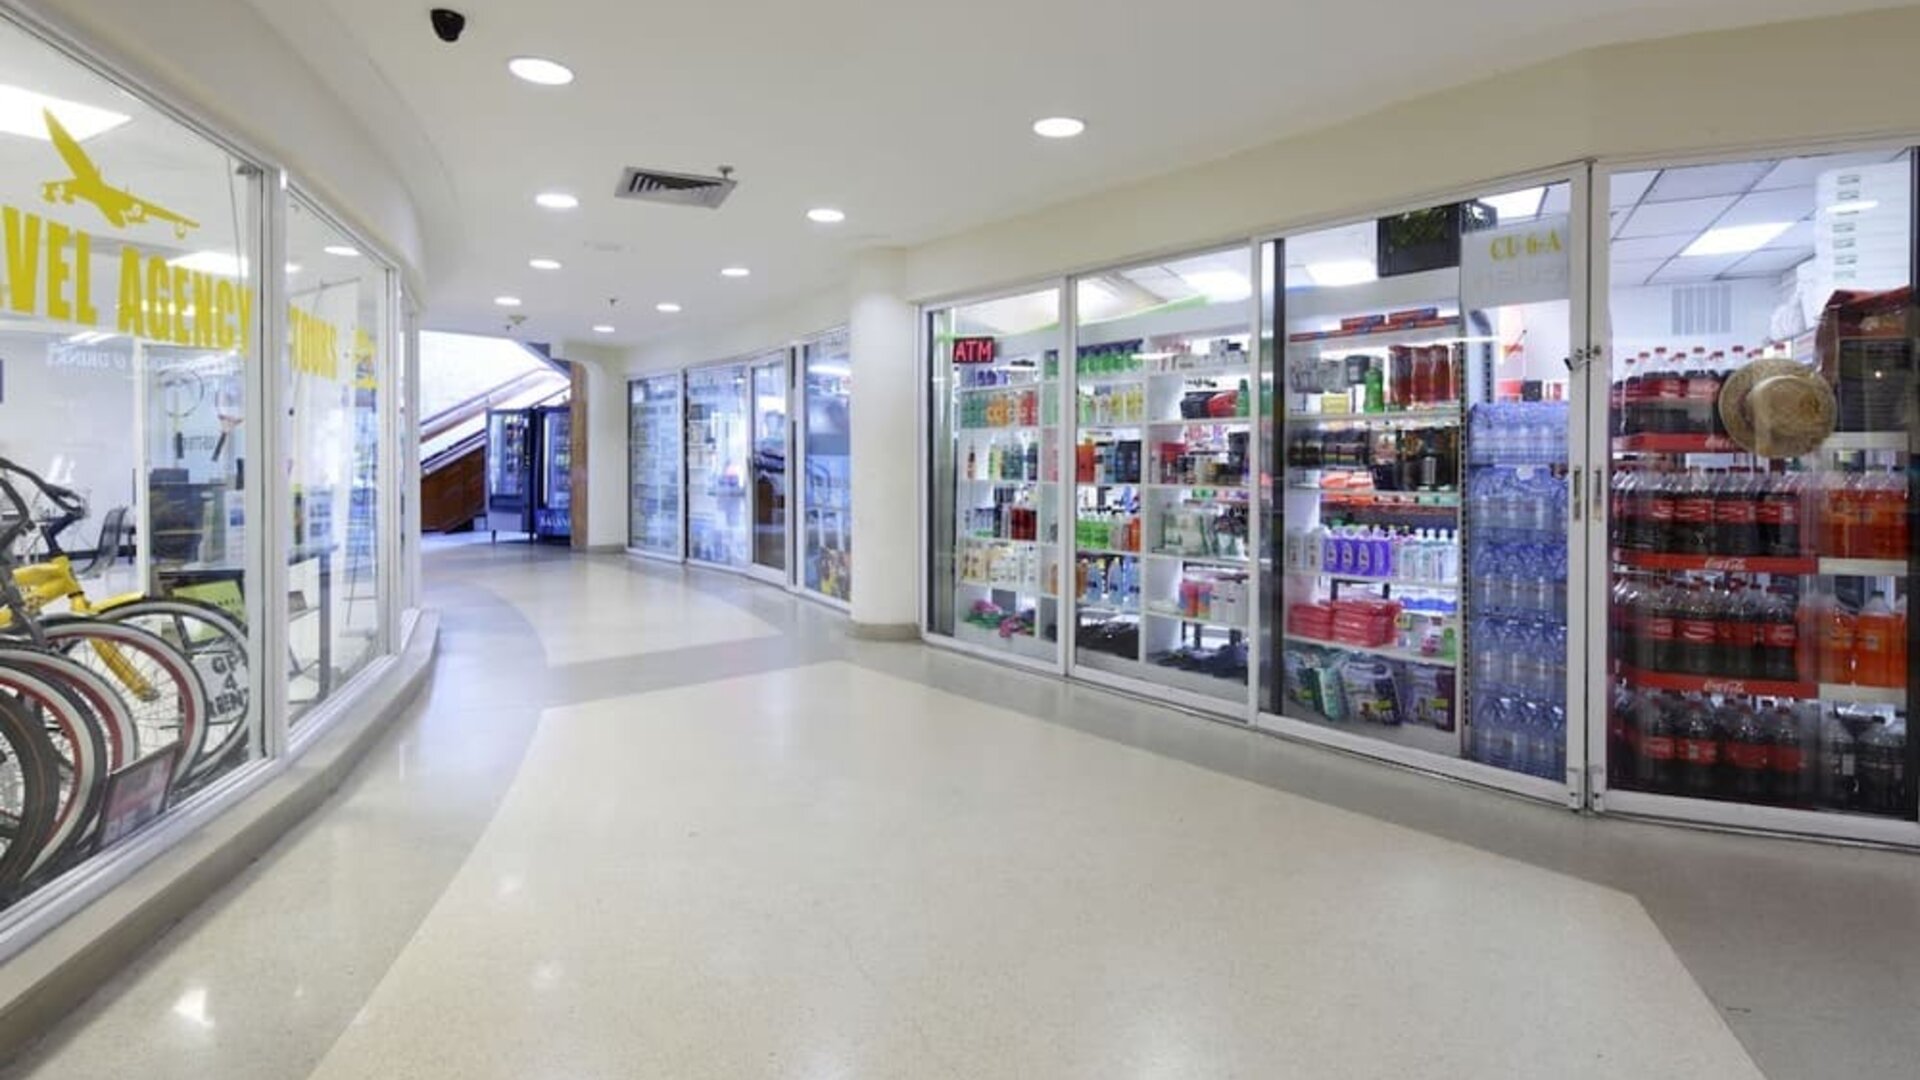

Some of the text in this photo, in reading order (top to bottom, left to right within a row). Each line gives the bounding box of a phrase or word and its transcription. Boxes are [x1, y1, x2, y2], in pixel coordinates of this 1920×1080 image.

[0, 205, 253, 358] VEL AGENCY
[289, 305, 337, 381] TOURS
[955, 341, 991, 361] ATM
